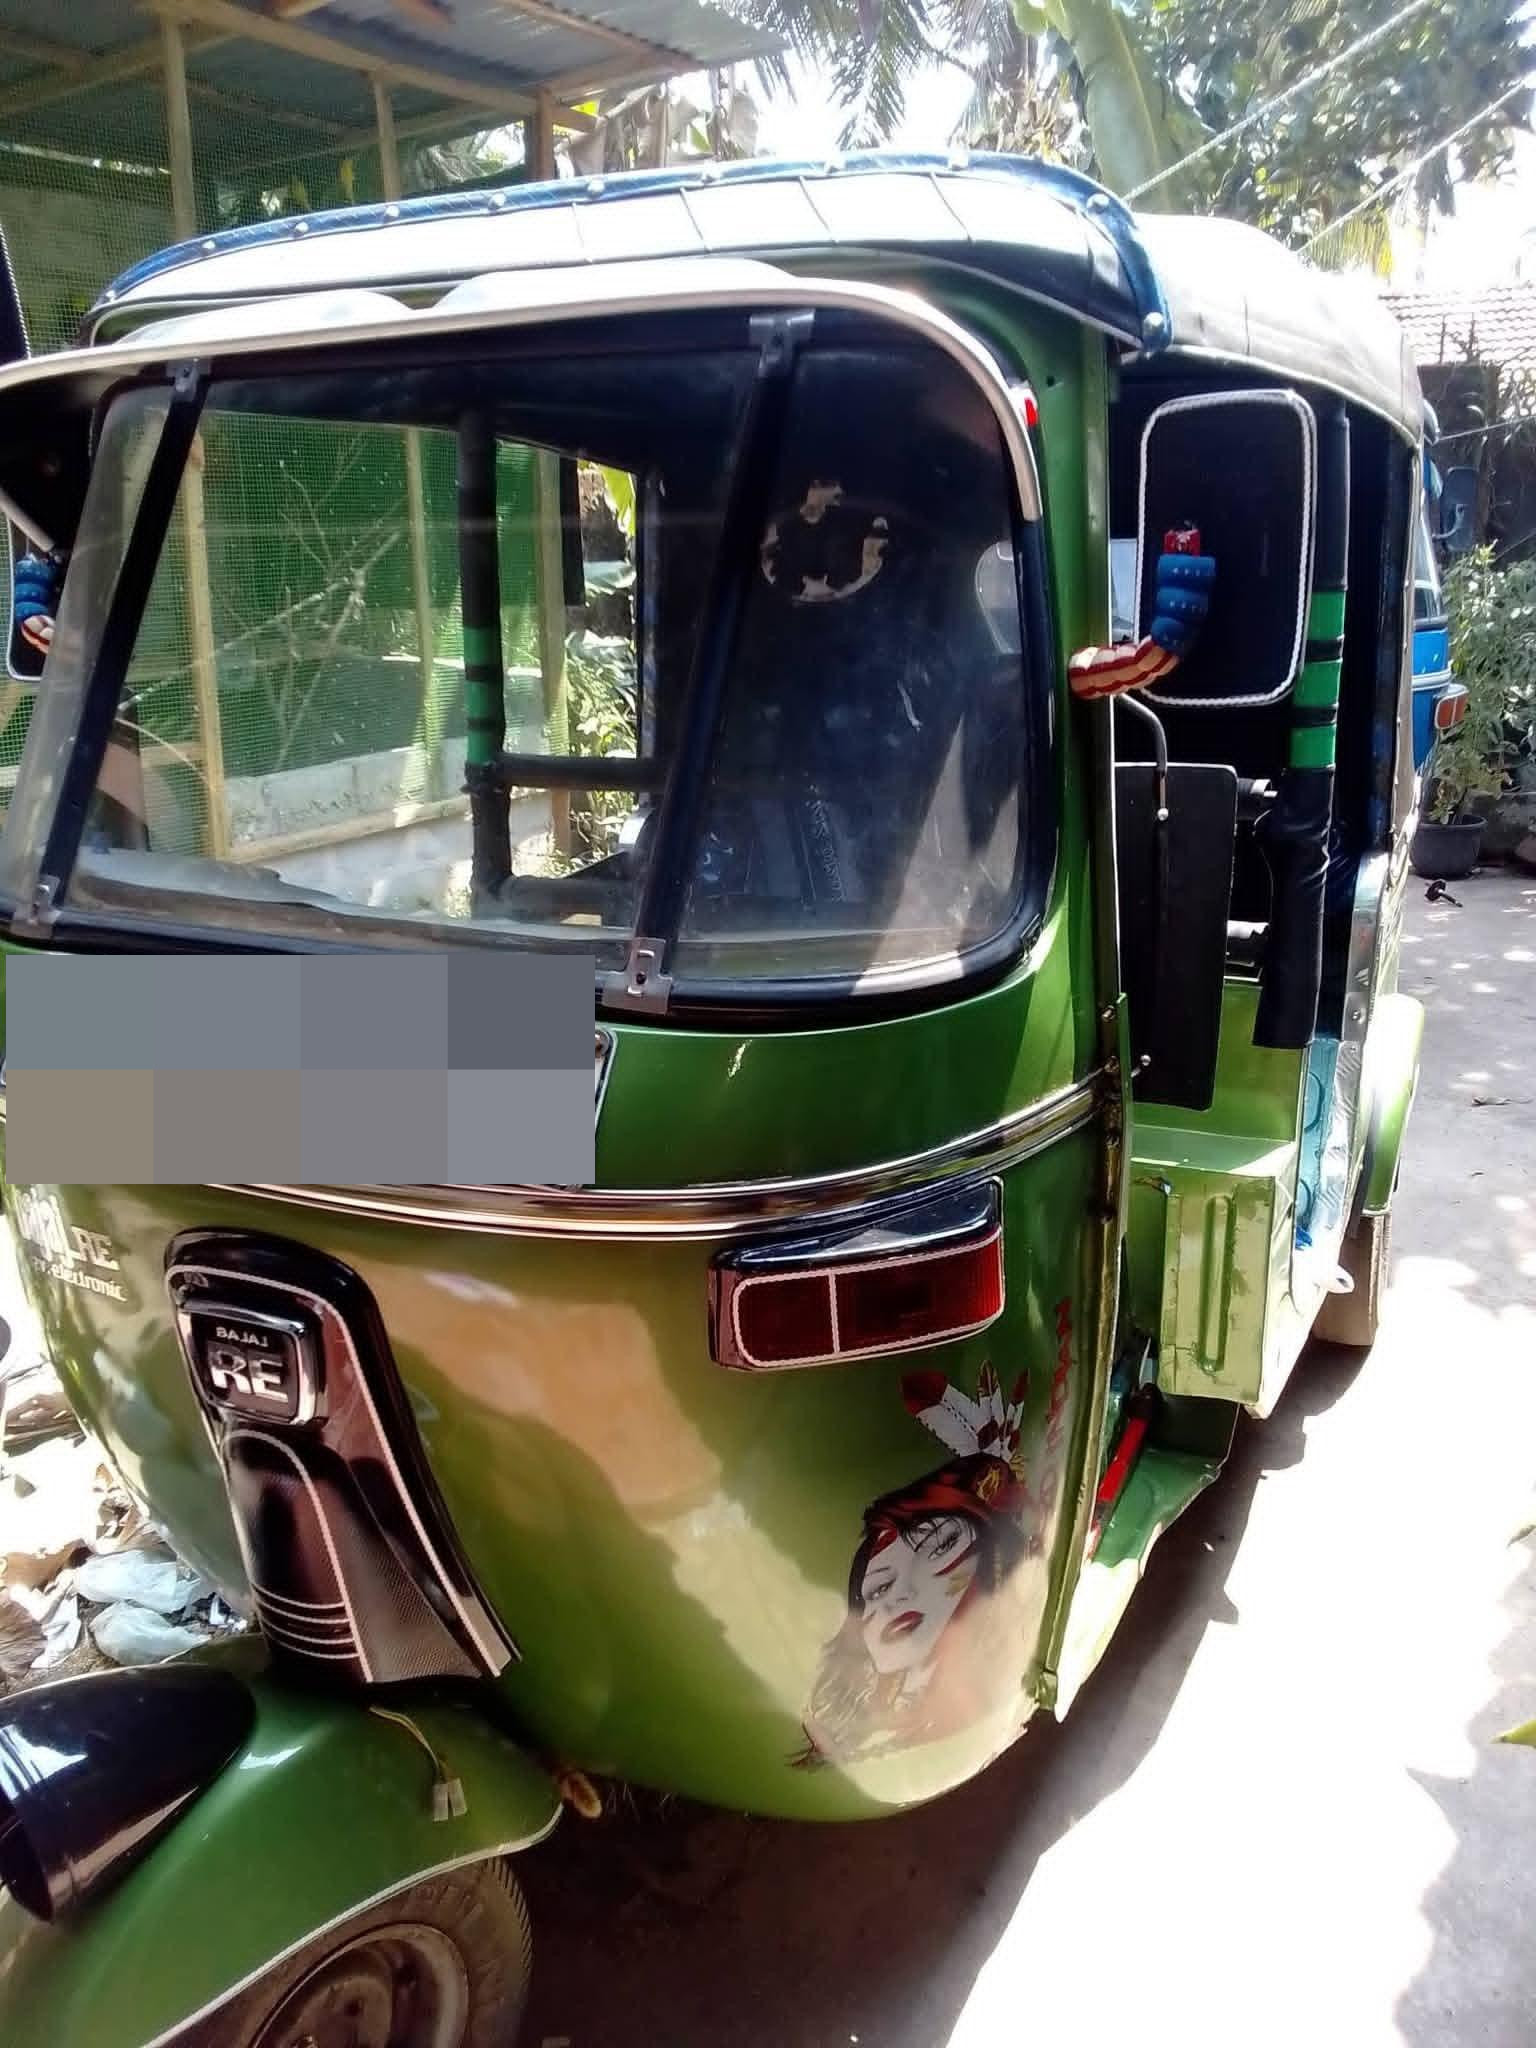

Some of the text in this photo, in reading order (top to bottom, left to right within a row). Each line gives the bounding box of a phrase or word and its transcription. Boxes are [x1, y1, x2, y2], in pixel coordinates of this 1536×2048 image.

[68, 1224, 121, 1272] RE
[215, 1326, 269, 1348] BAJAJ
[209, 1350, 289, 1403] RE
